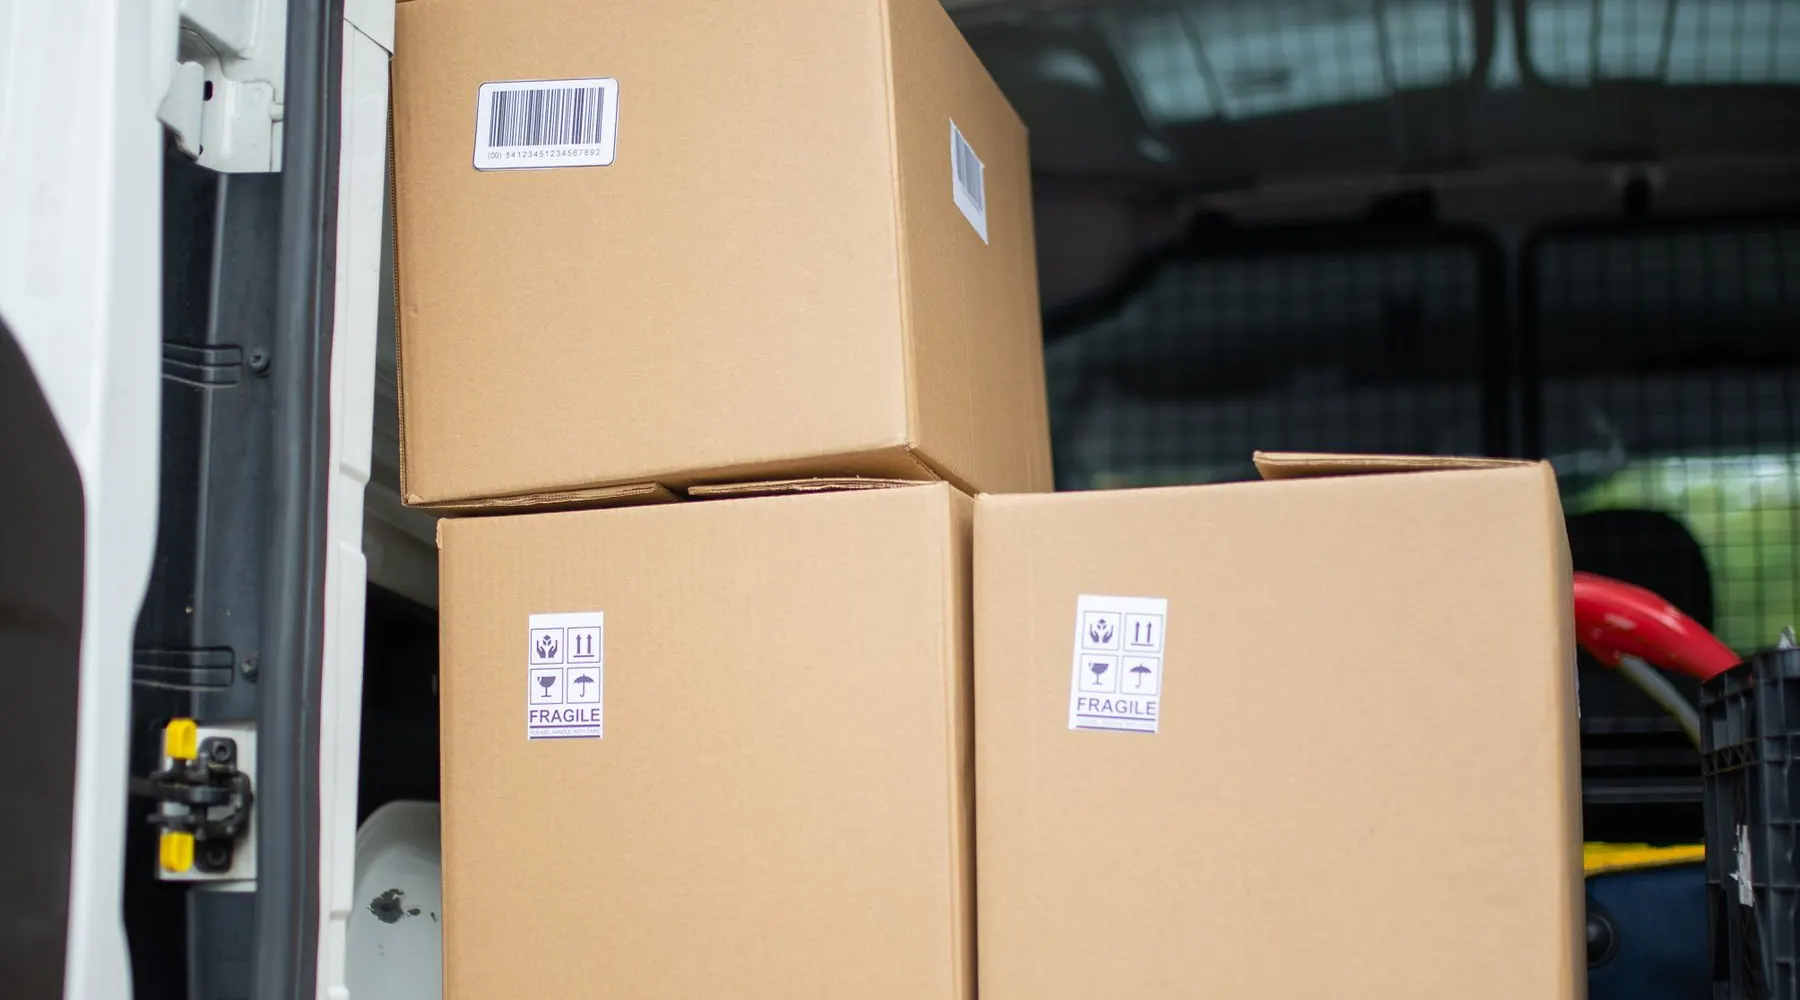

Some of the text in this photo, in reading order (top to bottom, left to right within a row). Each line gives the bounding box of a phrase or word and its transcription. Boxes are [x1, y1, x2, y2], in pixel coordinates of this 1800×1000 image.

[488, 148, 601, 160] (00) 54123451234567892
[1077, 697, 1156, 715] FRAGILE
[529, 708, 600, 723] FRAGILE
